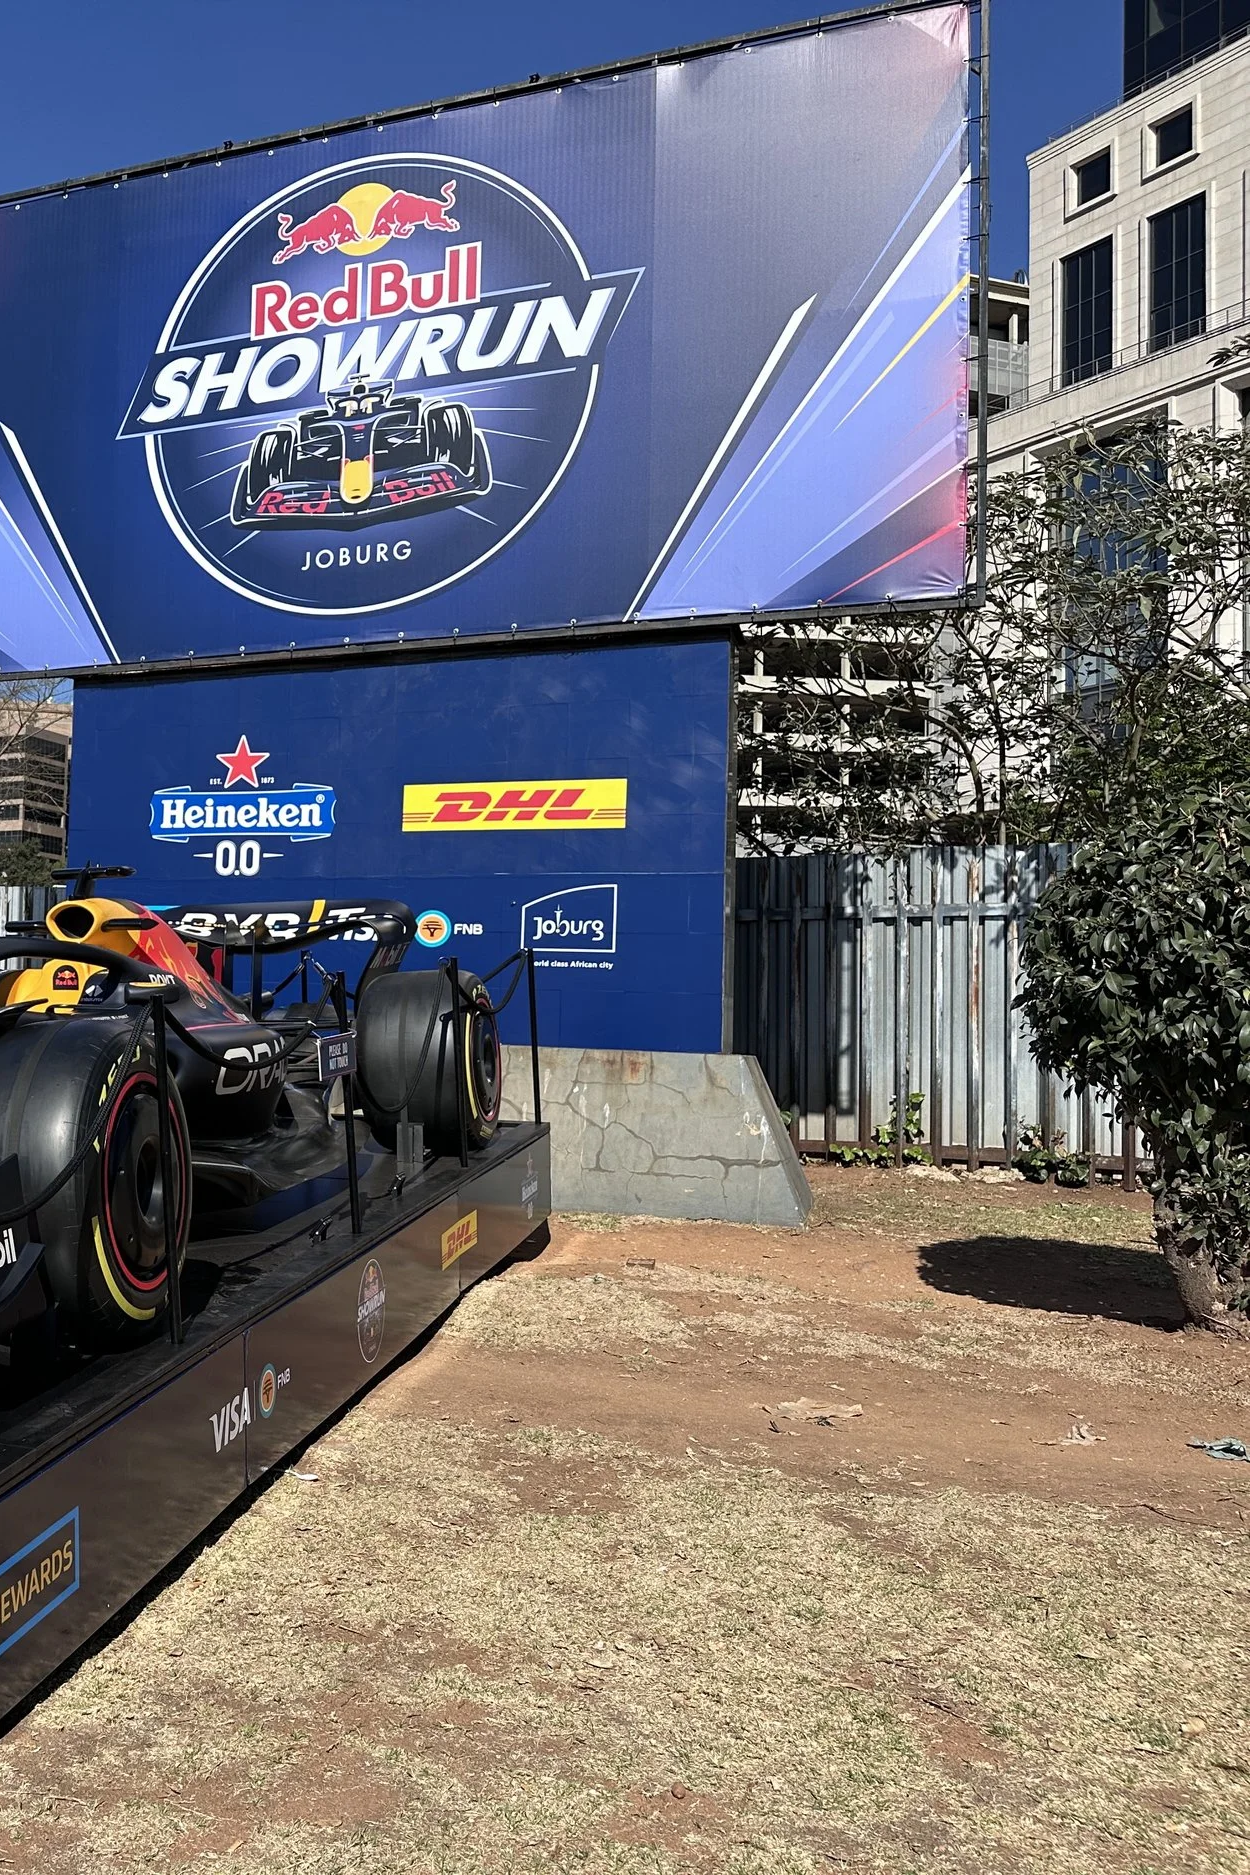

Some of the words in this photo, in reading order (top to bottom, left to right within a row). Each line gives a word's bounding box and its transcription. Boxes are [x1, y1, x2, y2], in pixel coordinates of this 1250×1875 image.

[251, 264, 359, 341] Red
[367, 241, 482, 320] Bull
[136, 286, 617, 424] SHOWRUN
[301, 540, 412, 571] JOBURG
[160, 797, 323, 829] Heineken
[432, 788, 592, 823] DHL
[215, 839, 261, 877] 0.0
[453, 923, 484, 936] FNB
[532, 904, 605, 942] Joburg
[533, 959, 550, 968] orld
[550, 959, 569, 969] class
[569, 959, 598, 970] African
[598, 960, 614, 970] city
[446, 1219, 472, 1261] DHL
[209, 1387, 251, 1454] VISA
[277, 1367, 291, 1391] FNB
